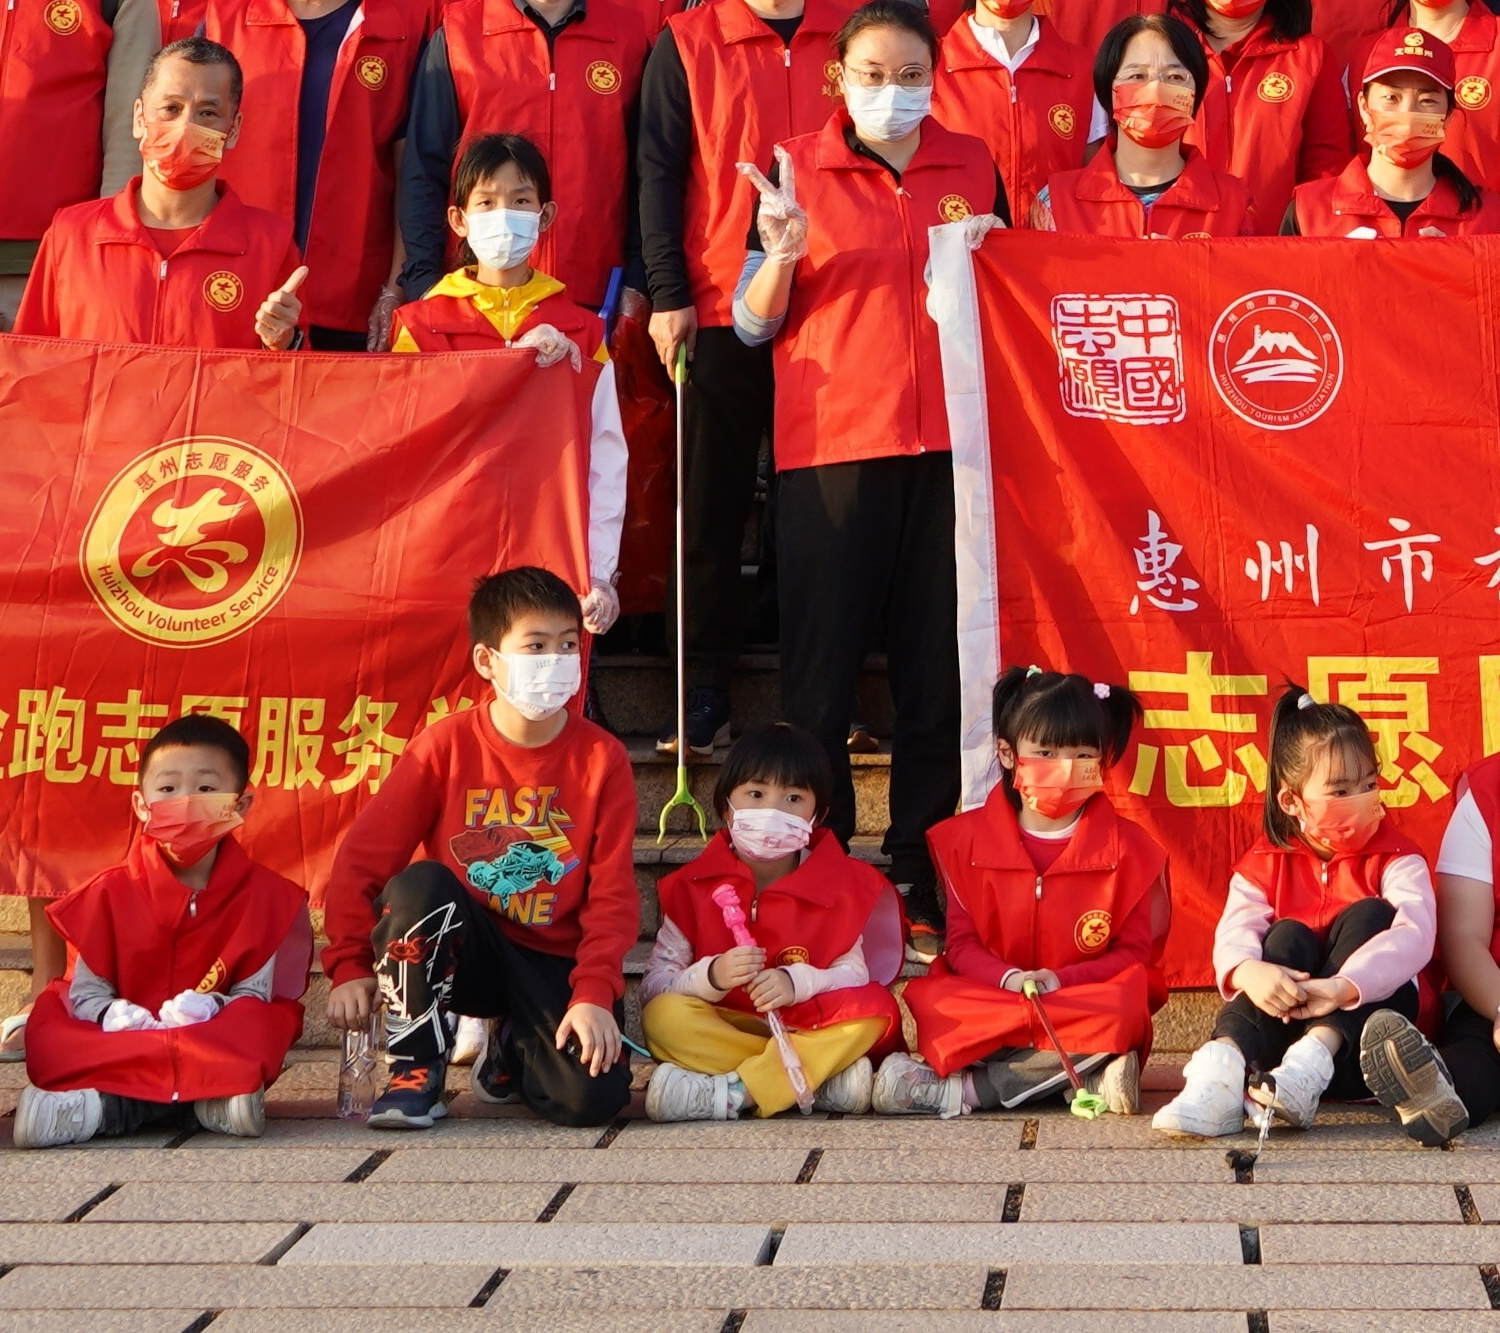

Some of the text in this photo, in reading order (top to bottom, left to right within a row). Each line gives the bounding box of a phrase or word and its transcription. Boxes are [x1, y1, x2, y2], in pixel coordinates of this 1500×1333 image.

[1250, 408, 1290, 422] TOURISM
[1293, 373, 1335, 420] ASSOCIATION
[133, 451, 270, 493] 惠州志愿服务
[98, 564, 279, 633] Huizhou Volunteer Service
[465, 785, 559, 828] FAST
